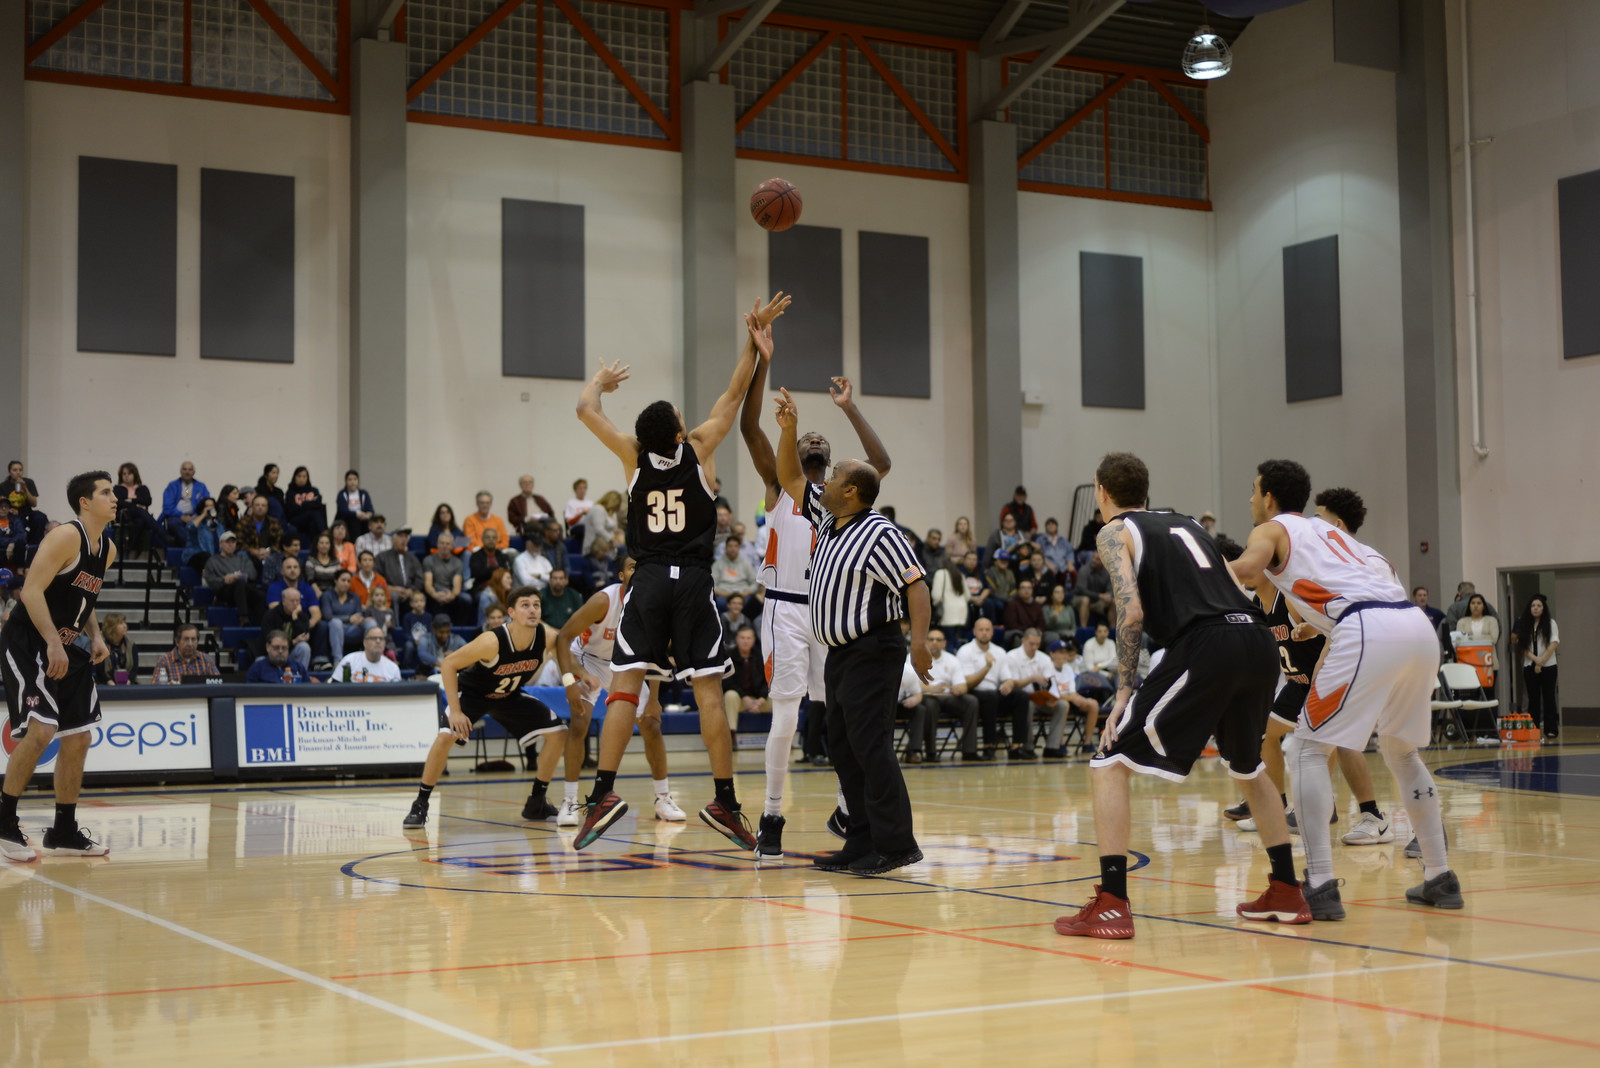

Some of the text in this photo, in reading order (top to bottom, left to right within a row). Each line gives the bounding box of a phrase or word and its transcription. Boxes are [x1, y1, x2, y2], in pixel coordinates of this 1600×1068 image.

[647, 489, 686, 533] 35
[1169, 527, 1212, 568] 1
[495, 675, 522, 694] 21
[296, 706, 371, 719] Buckman-
[297, 719, 393, 733] Mitchell, Inc.
[298, 736, 367, 744] Buckman-Mitchell
[298, 744, 333, 752] Financial
[344, 743, 381, 751] Insurance
